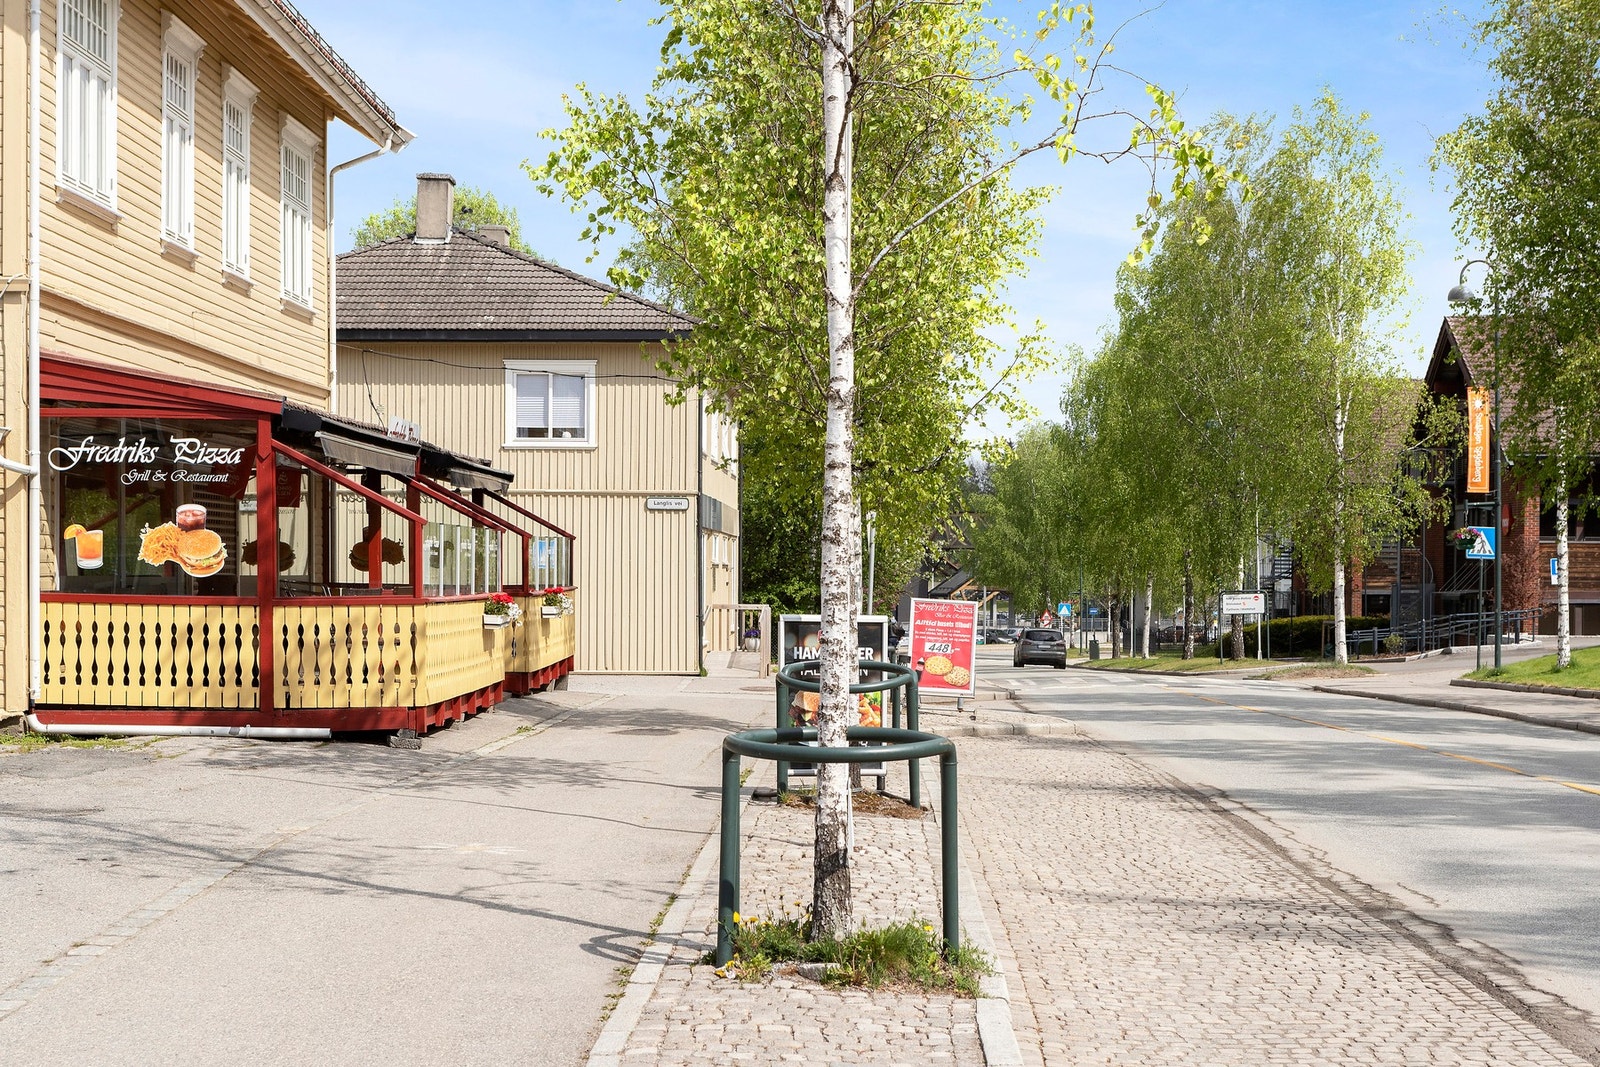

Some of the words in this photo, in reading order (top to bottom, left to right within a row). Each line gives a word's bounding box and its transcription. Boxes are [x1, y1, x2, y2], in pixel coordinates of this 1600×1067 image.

[48, 435, 159, 471] Fredriks
[170, 435, 245, 464] Pizza
[120, 469, 149, 485] Grill
[152, 471, 167, 482] &
[170, 469, 229, 482] Restaurant
